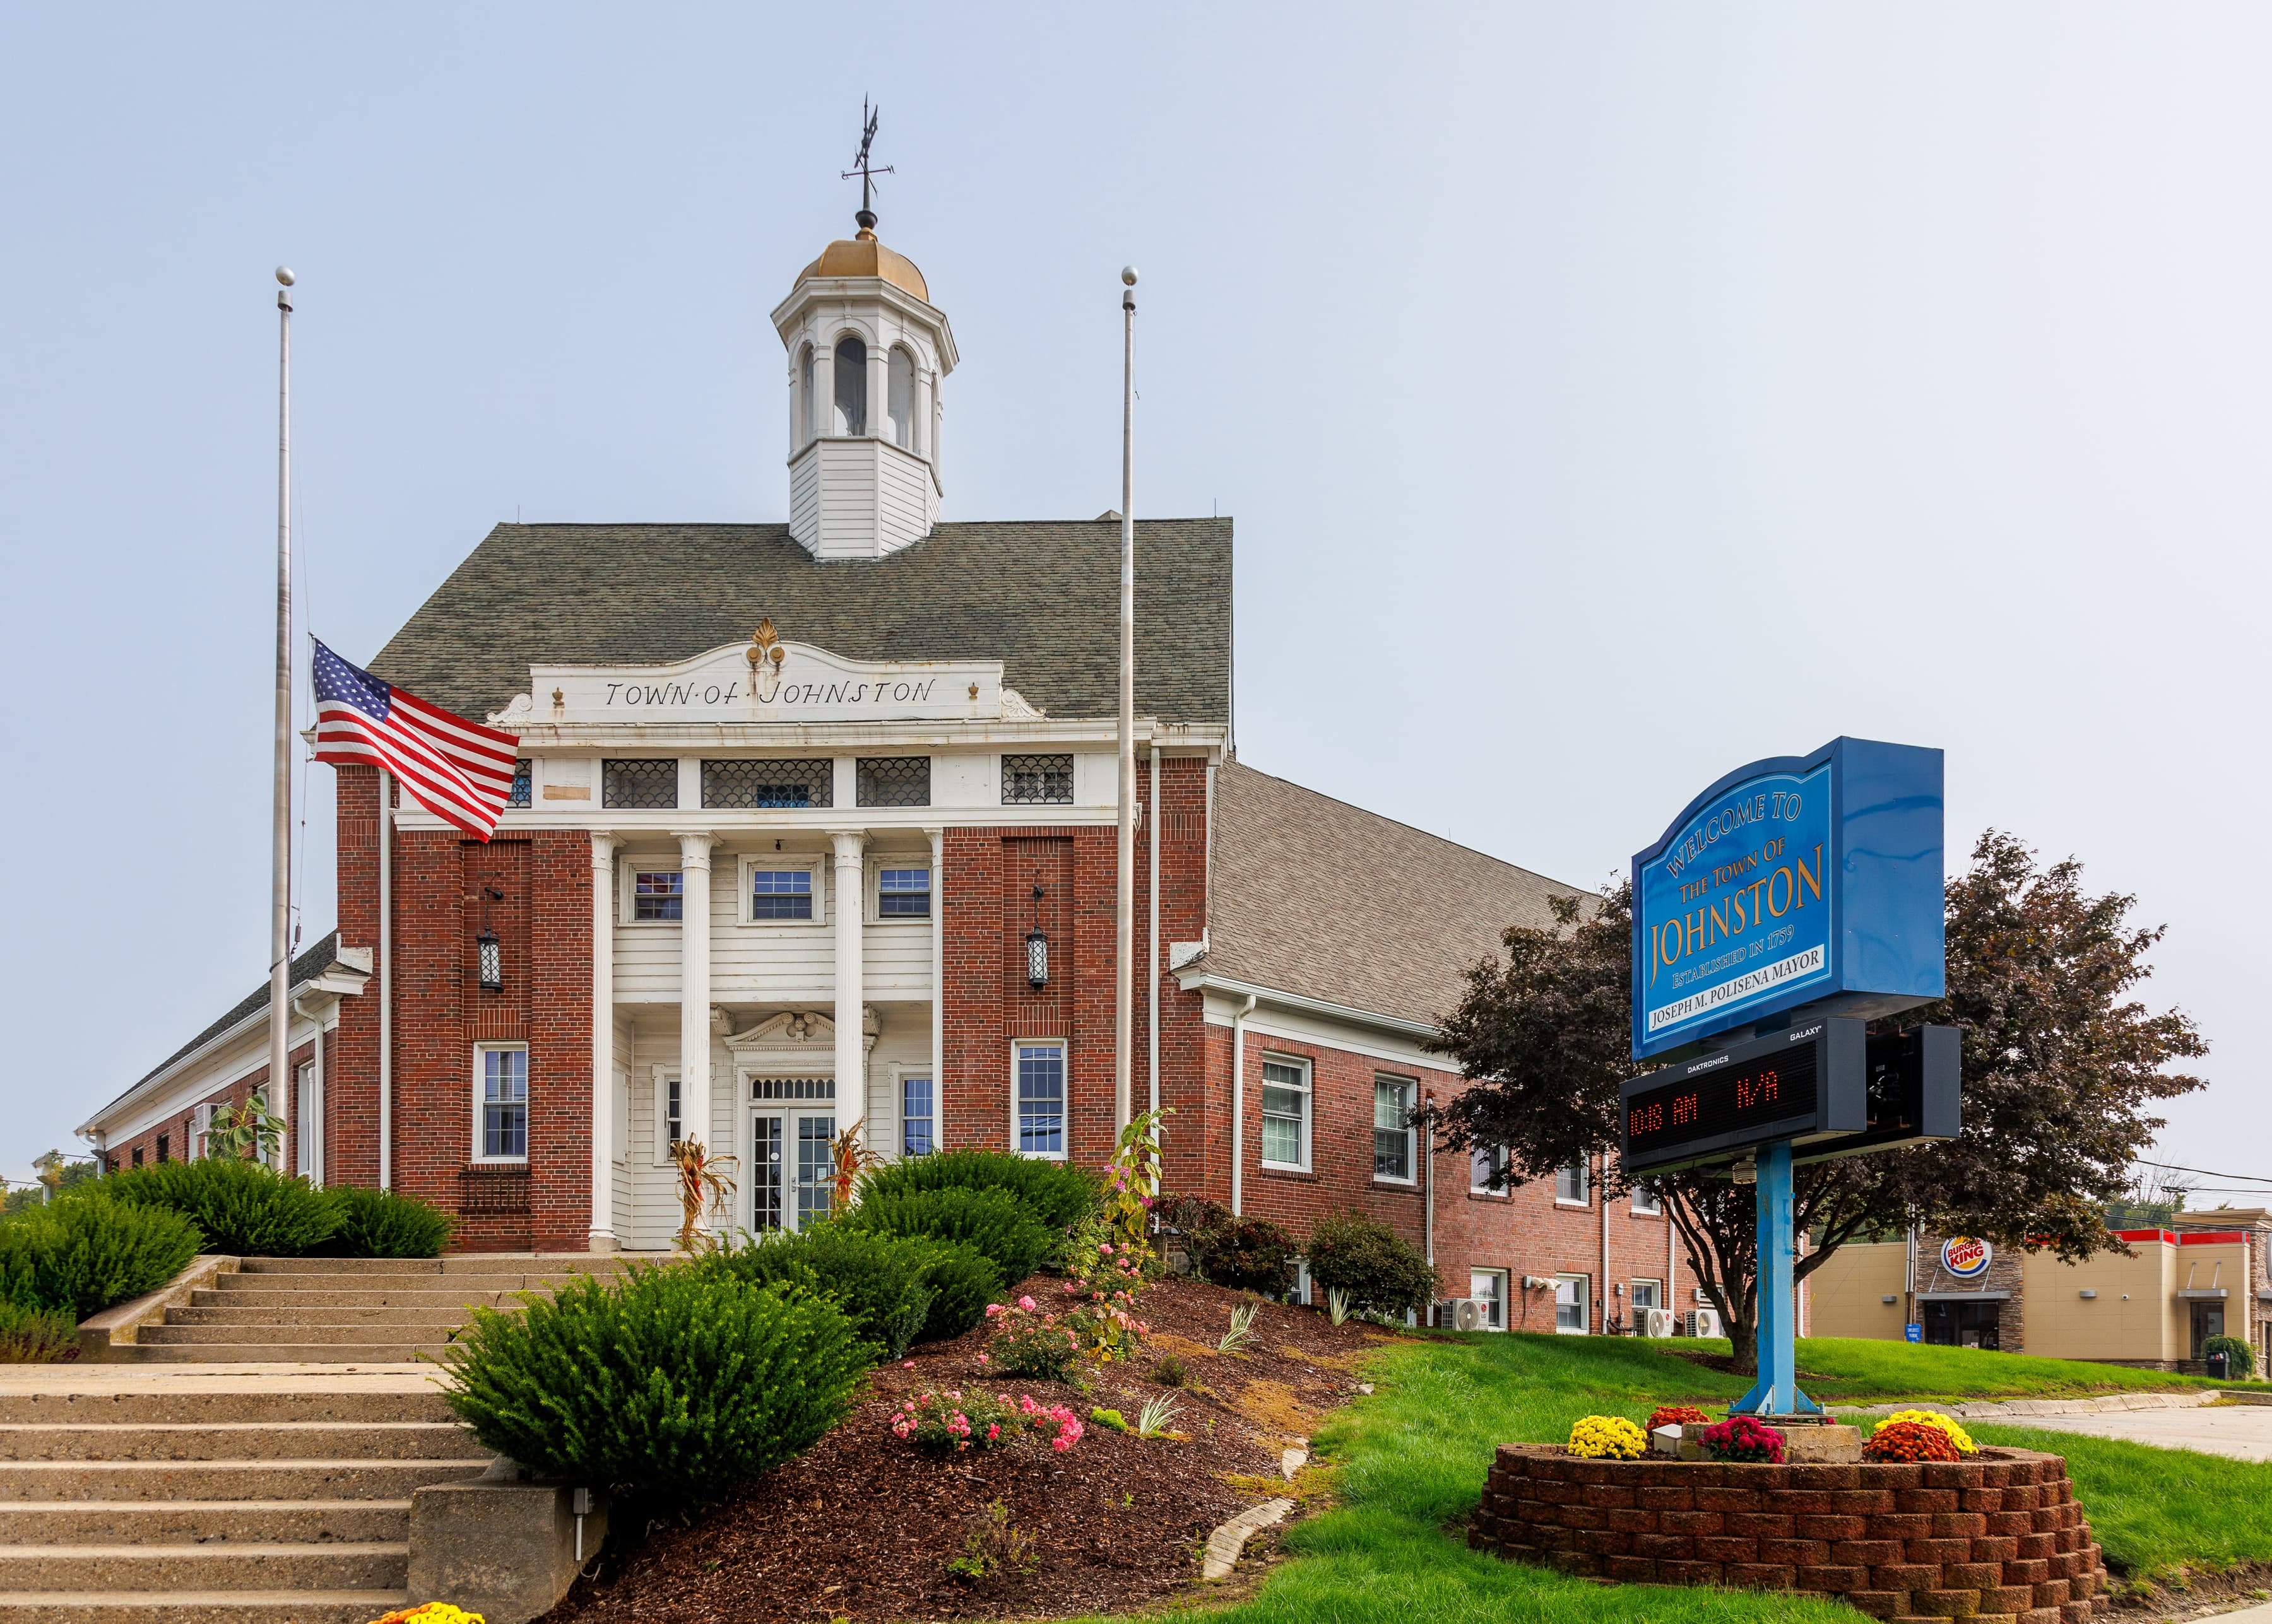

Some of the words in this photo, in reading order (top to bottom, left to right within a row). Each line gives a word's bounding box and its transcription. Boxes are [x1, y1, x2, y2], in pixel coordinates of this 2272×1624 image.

[606, 682, 694, 705] TOWN
[759, 679, 936, 703] JOHNSTON
[1667, 794, 1765, 878] WELCOME
[1772, 792, 1802, 821] TO
[1679, 876, 1708, 904] THE
[1712, 850, 1758, 888] TOWN
[1763, 836, 1785, 861] OF
[1649, 842, 1823, 989] JOHNSTON
[1652, 1001, 1692, 1028] JOSEPH
[1695, 994, 1707, 1010] M.
[1710, 970, 1769, 1003] POLISENA
[1772, 950, 1819, 980] MAYOR
[1672, 948, 1746, 989] ESTABLISHED
[1749, 939, 1764, 958] IN
[1768, 924, 1794, 951] 1759
[1688, 1055, 1729, 1074] DAKTRONICS
[1631, 1103, 1662, 1136] 10:18
[1673, 1093, 1696, 1124] AM
[1737, 1071, 1777, 1109] N/A
[1948, 1239, 1982, 1257] BURGR
[1950, 1246, 1984, 1268] KING
